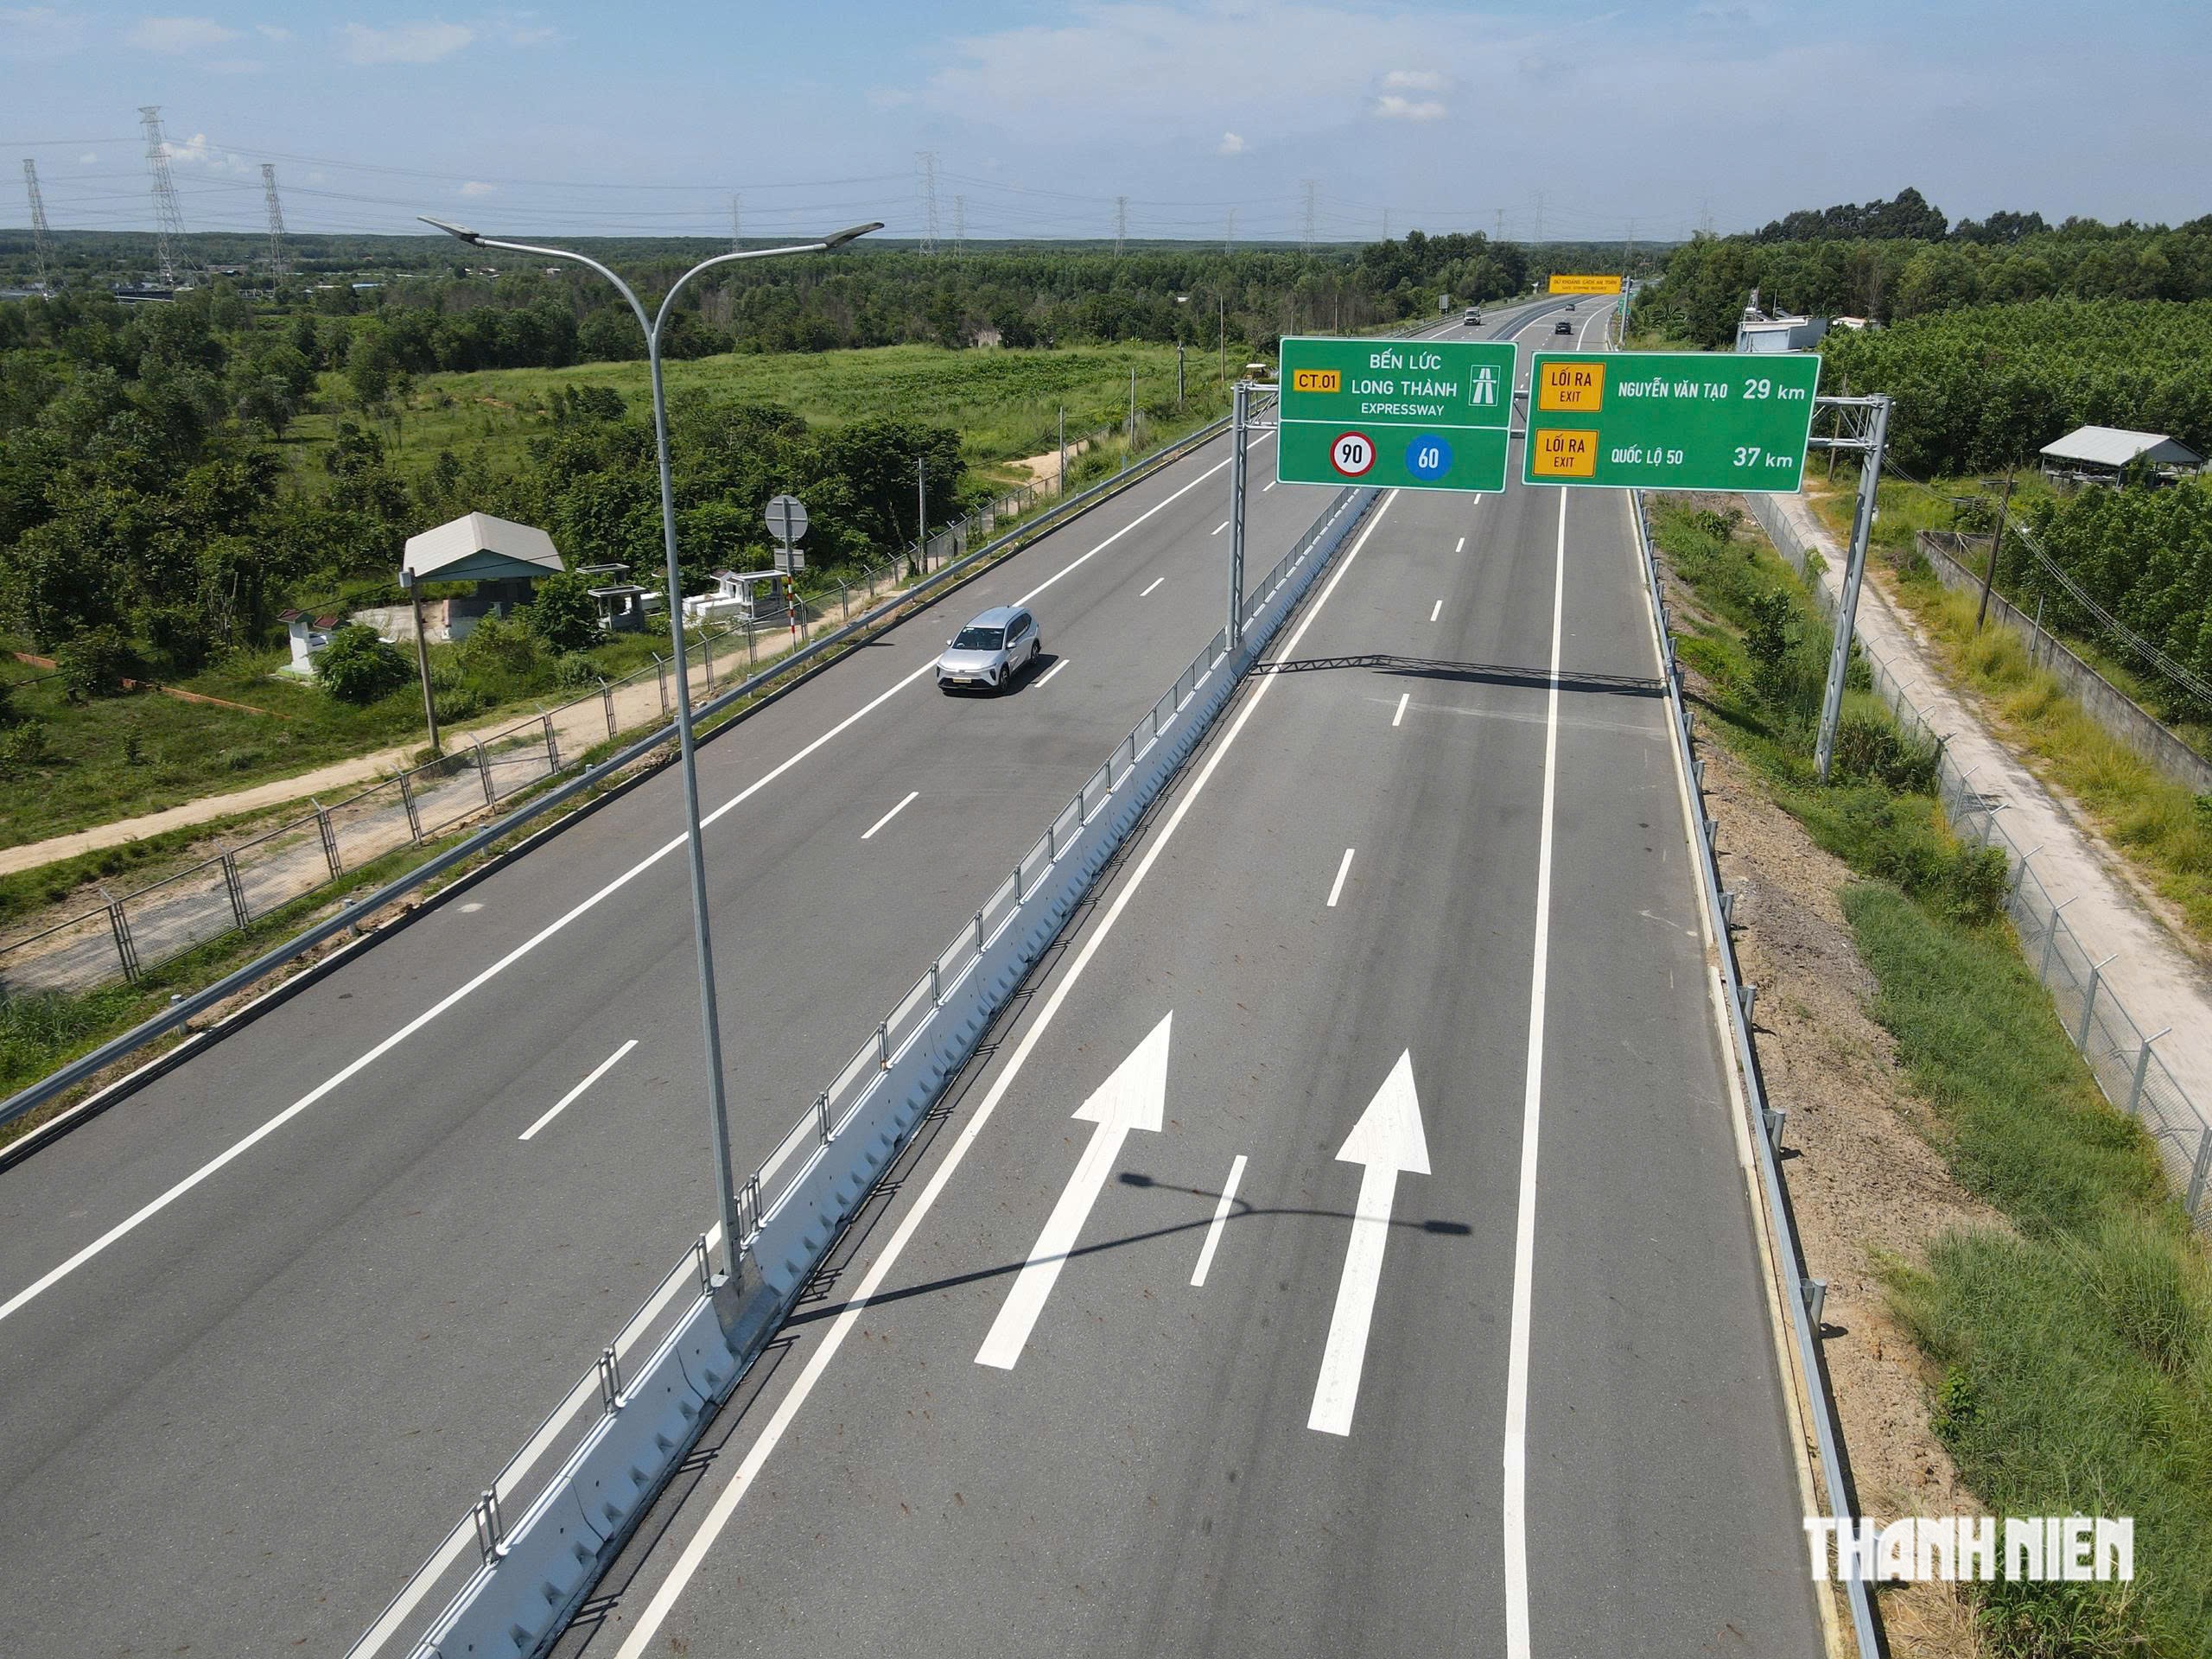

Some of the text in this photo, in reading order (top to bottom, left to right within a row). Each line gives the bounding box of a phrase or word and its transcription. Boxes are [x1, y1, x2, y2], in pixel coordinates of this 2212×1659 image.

[1370, 347, 1442, 371] BẾN LỨC
[1299, 373, 1336, 389] CT.01
[1551, 366, 1592, 387] LỐI RA
[1351, 378, 1458, 397] LONG THÀNH
[1560, 391, 1581, 403] EXIT
[1618, 377, 1806, 402] NGUYỄN VĂN TẠO 29 km
[1361, 403, 1445, 416] EXPRESSWAY
[1546, 433, 1585, 454] LỐI RA
[1342, 444, 1363, 464] 90
[1418, 448, 1440, 469] 60
[1554, 456, 1574, 468] EXIT
[1611, 443, 1793, 469] QUỐC LỘ 50 37 km
